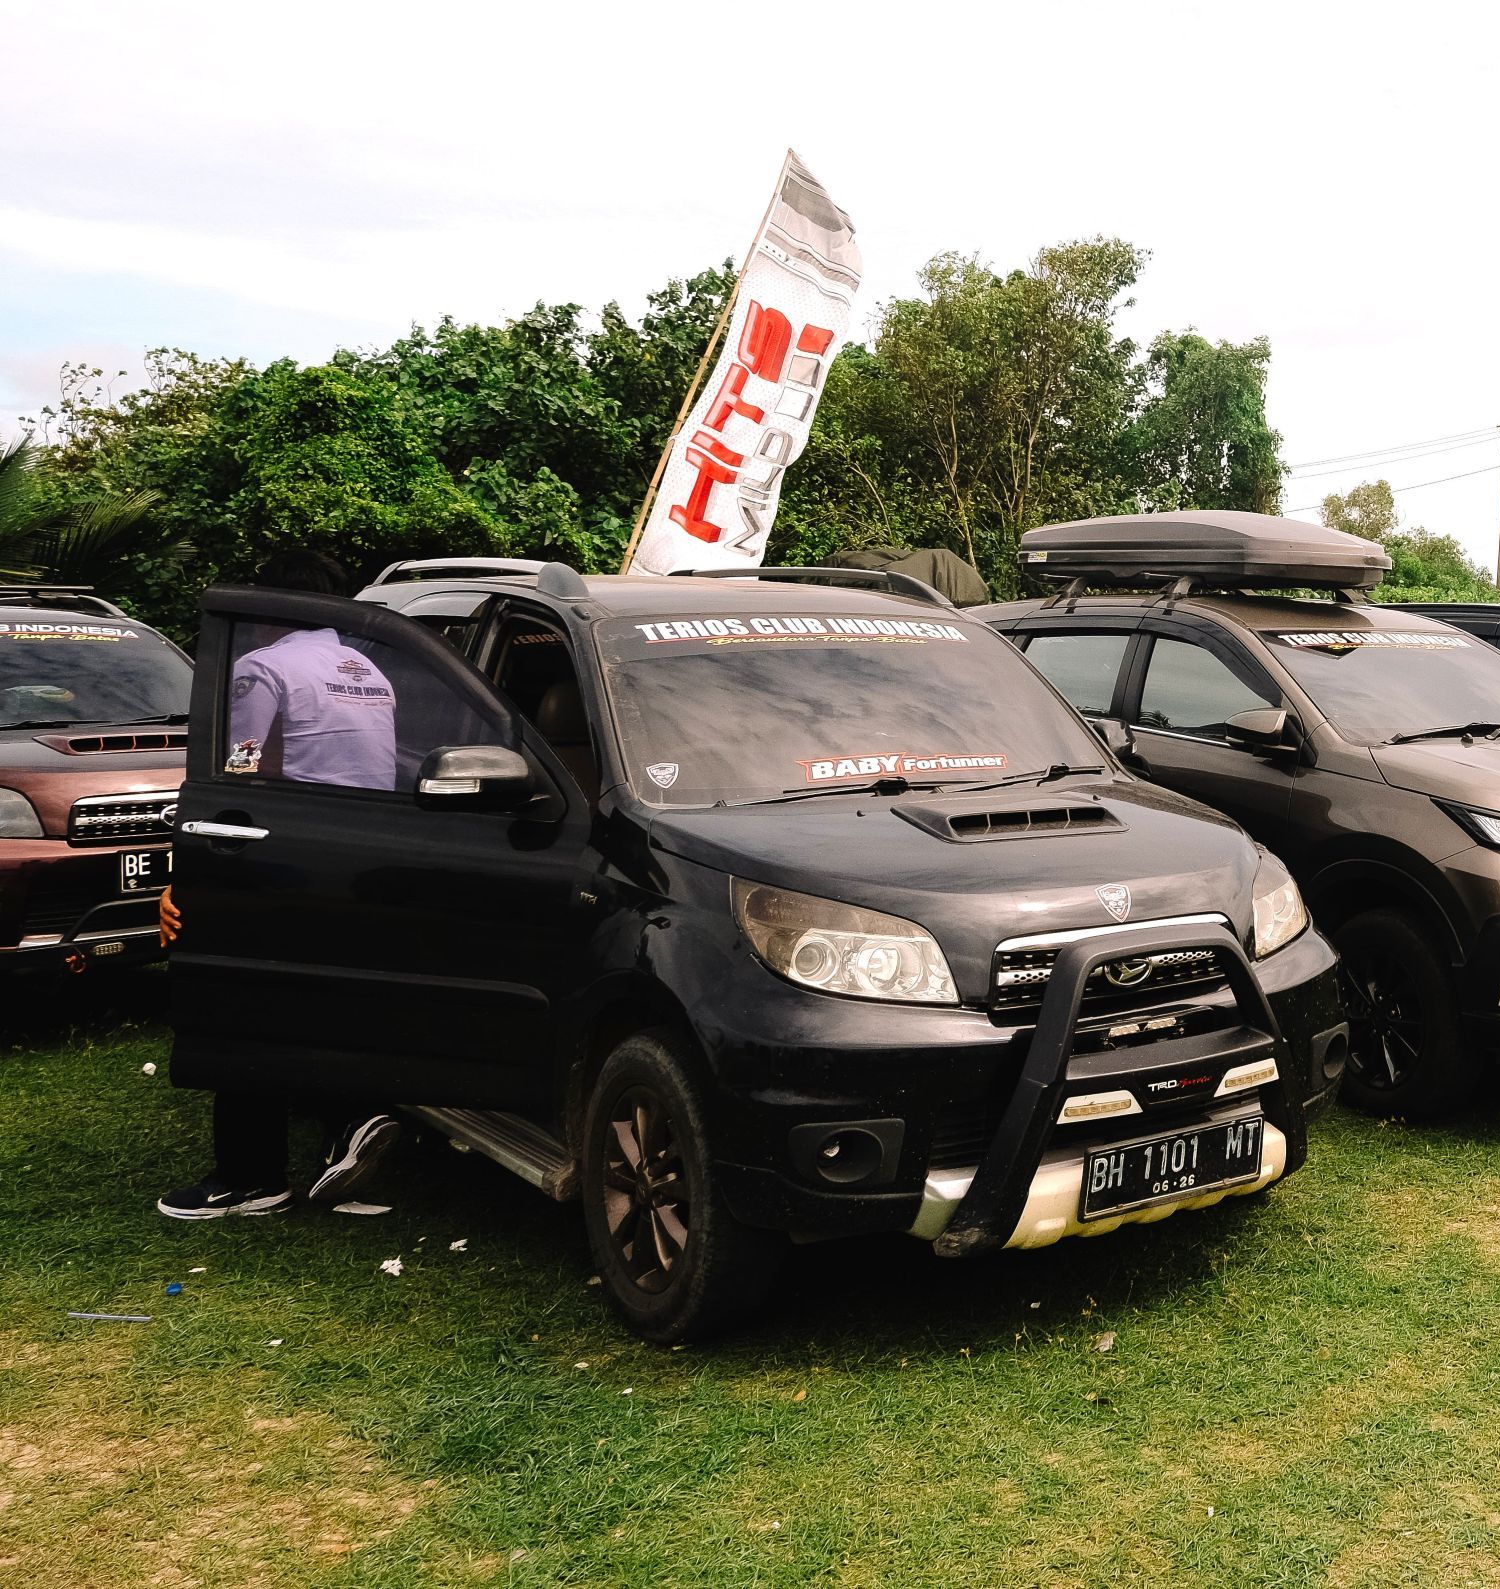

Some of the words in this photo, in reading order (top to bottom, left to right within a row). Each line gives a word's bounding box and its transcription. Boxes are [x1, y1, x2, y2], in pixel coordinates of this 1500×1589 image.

[669, 299, 792, 543] HITS
[15, 624, 139, 639] INDONESIA
[634, 618, 747, 642] TERIOS
[750, 617, 828, 635] CLUB
[826, 618, 970, 642] INDONESIA
[1278, 632, 1344, 648] TERIOS
[1343, 631, 1385, 645] CLUB
[811, 755, 900, 780] BABY
[903, 755, 1004, 771] Fortunner
[125, 853, 151, 877] BE
[1147, 1079, 1178, 1092] TRD
[1091, 1152, 1125, 1194] BH
[1144, 1135, 1199, 1180] 1101
[1225, 1122, 1260, 1160] MT
